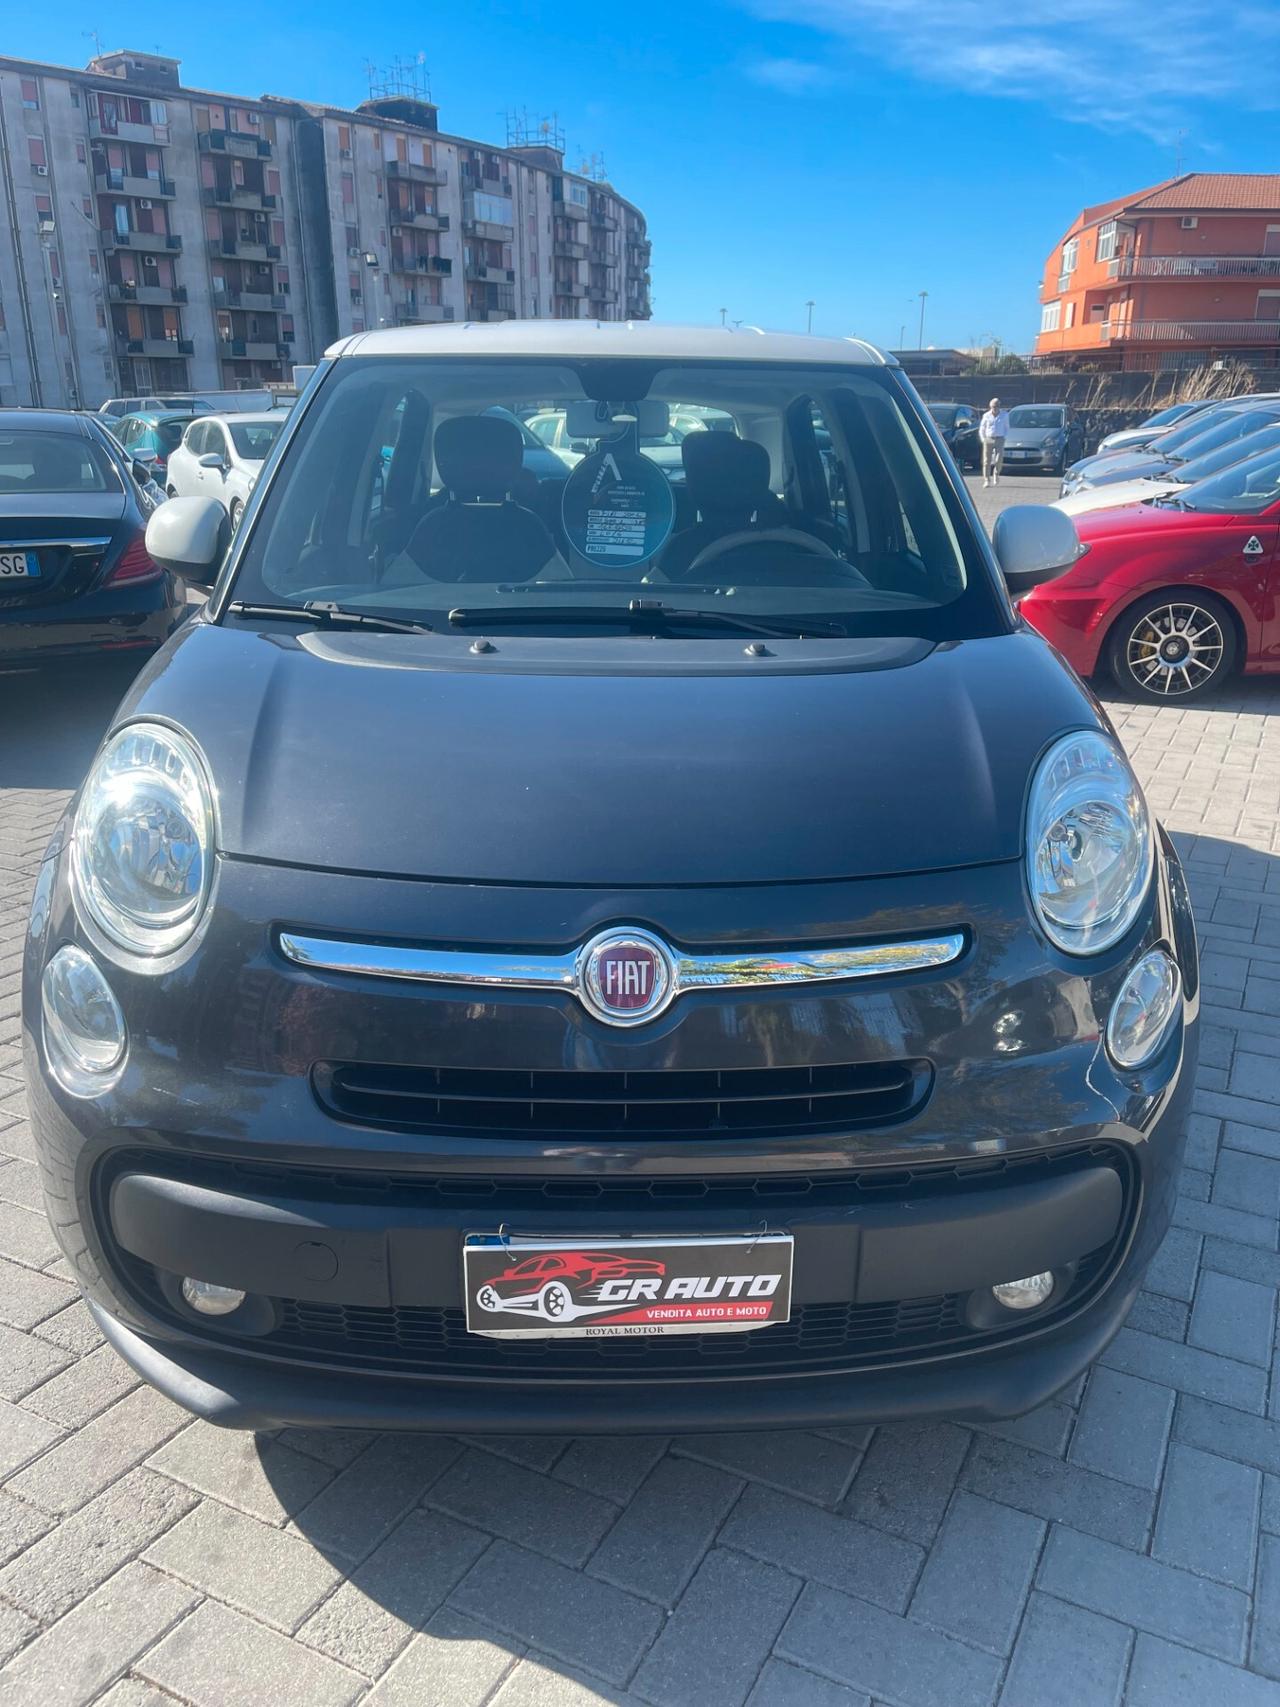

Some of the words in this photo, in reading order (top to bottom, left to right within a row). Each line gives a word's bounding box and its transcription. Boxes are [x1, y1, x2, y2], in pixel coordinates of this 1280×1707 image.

[0, 555, 25, 575] SG
[606, 960, 651, 995] FIAT
[597, 1278, 663, 1301] GR
[663, 1274, 782, 1300] AUTO
[647, 1308, 693, 1319] VENDITA
[695, 1307, 724, 1317] AUTO
[727, 1307, 734, 1316] E
[736, 1306, 767, 1316] MOTO
[585, 1327, 622, 1336] ROYAL
[623, 1325, 665, 1335] MOTOR
